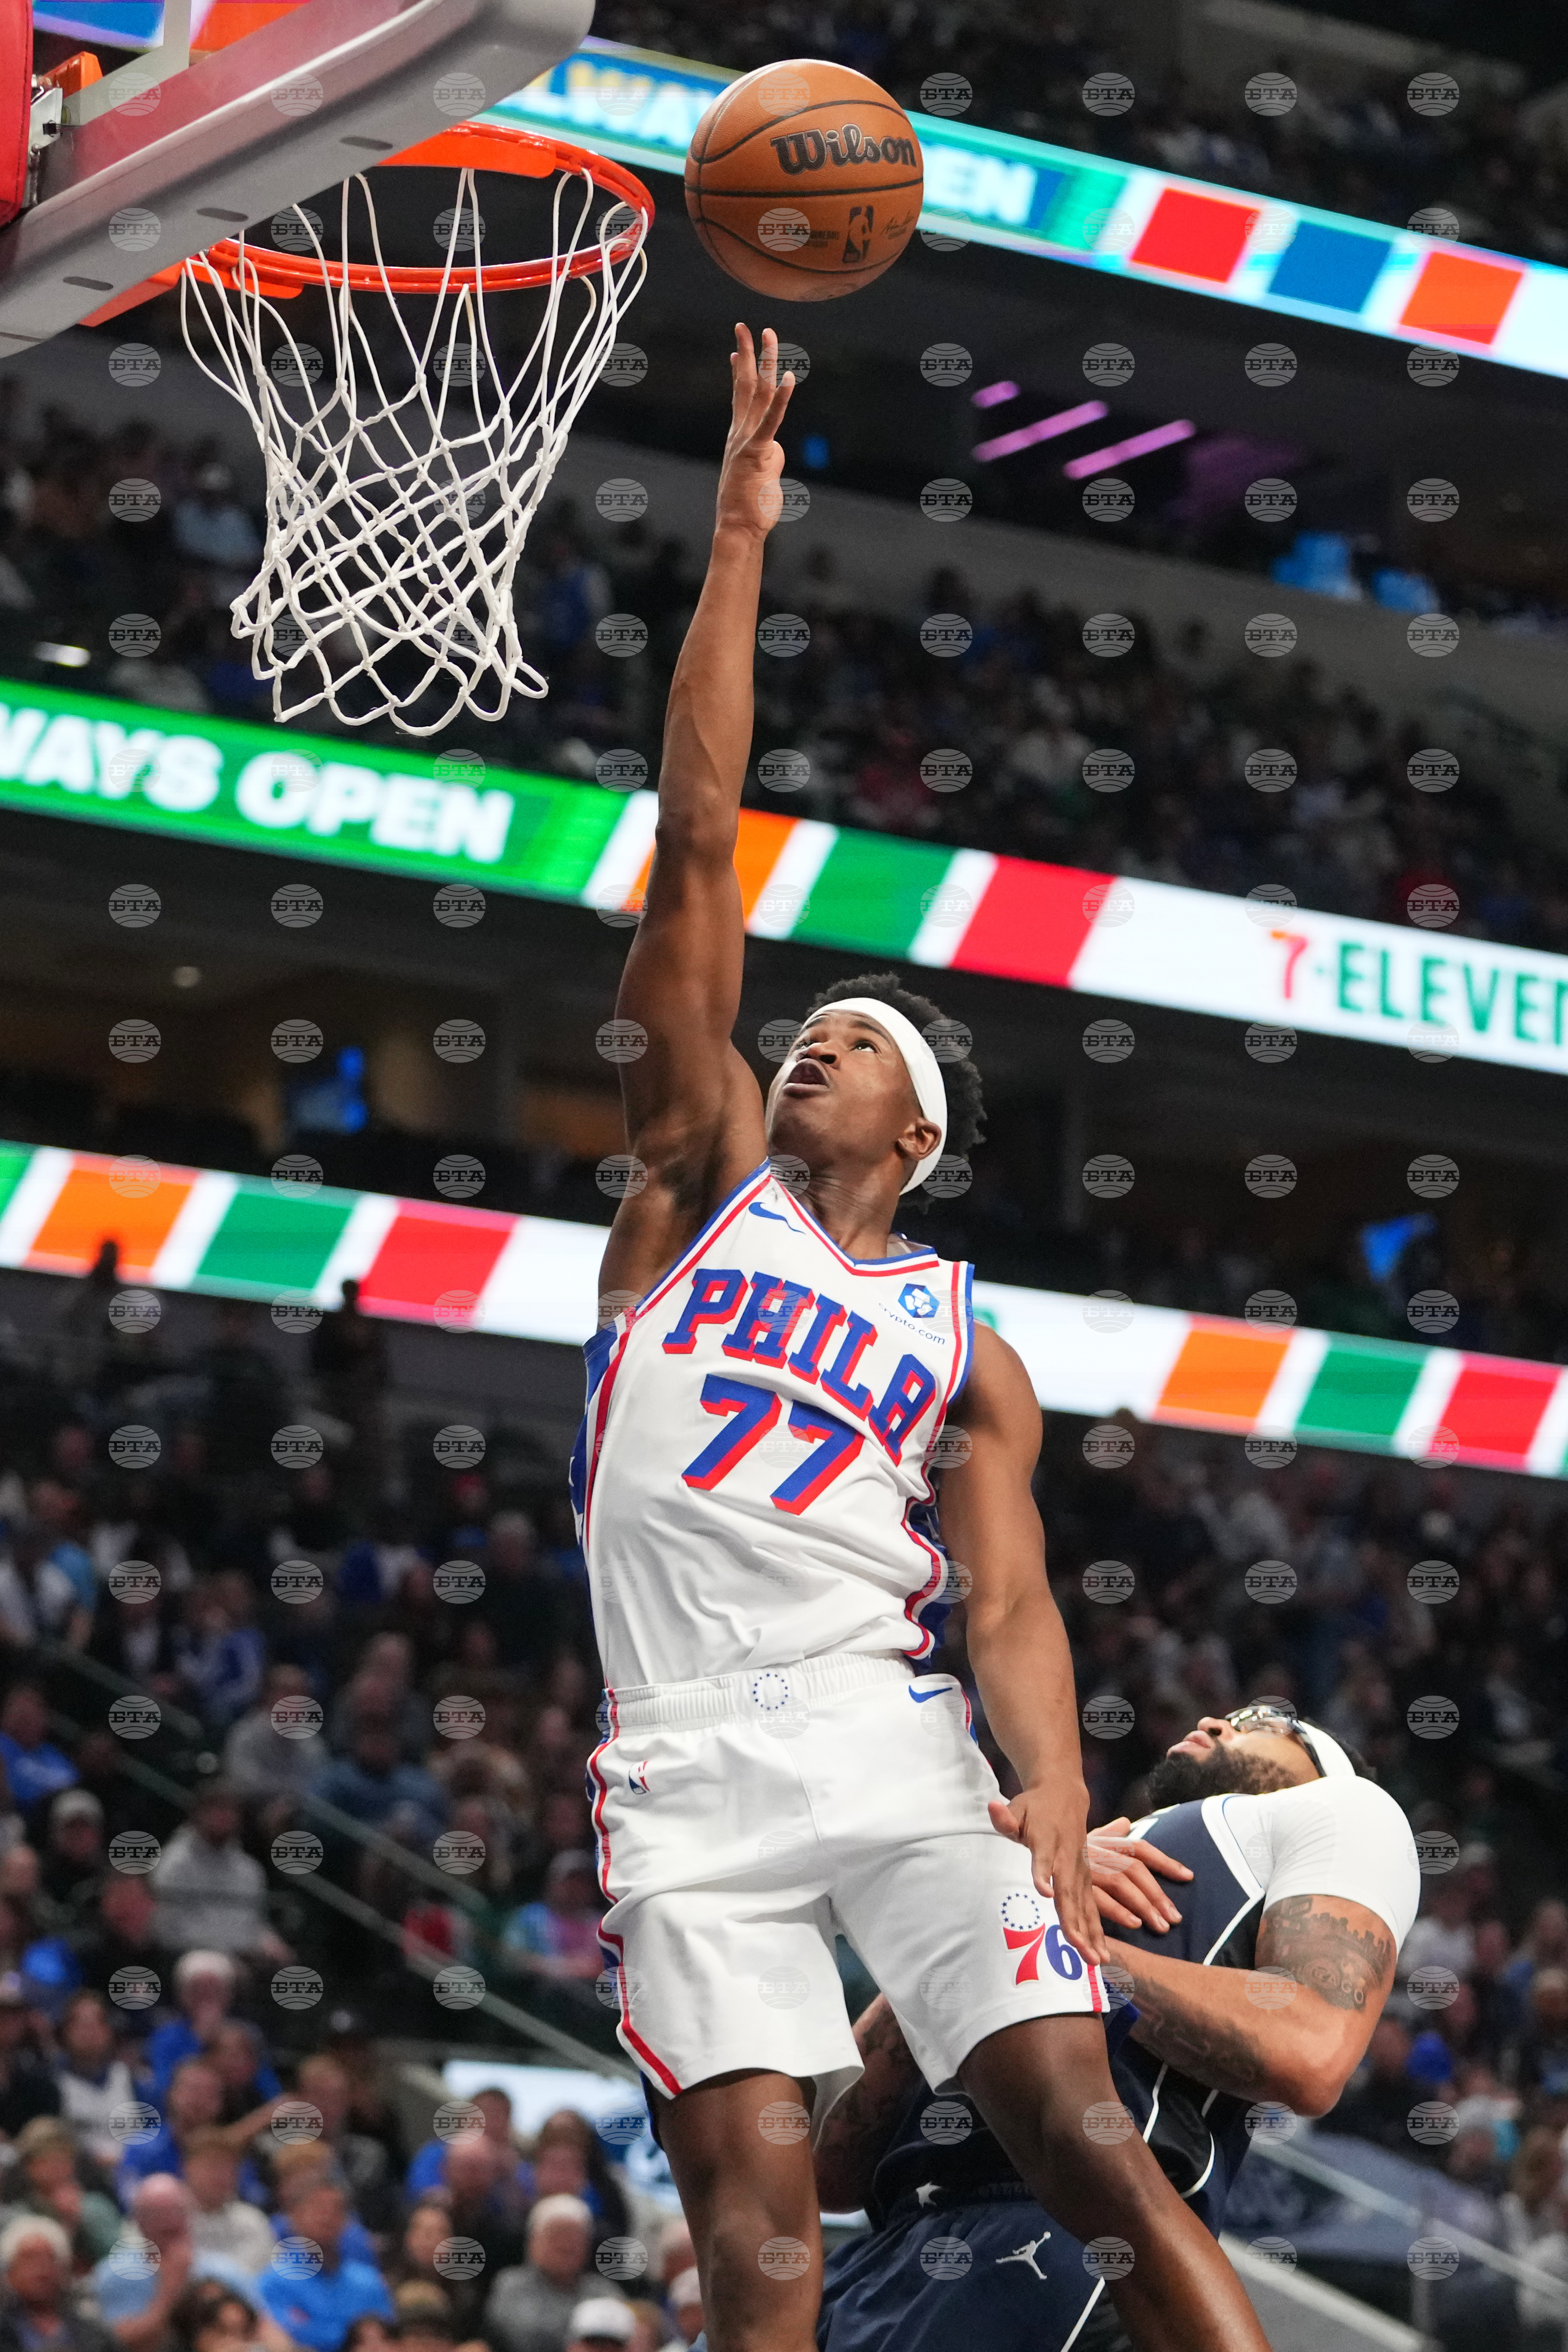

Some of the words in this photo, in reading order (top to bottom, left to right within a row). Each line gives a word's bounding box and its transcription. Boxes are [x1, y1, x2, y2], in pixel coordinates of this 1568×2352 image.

[770, 123, 917, 175] Wilson
[234, 750, 516, 865] OPEN
[661, 1268, 937, 1467] PHILA
[879, 1302, 945, 1345] crypto.com
[681, 1373, 867, 1516] 77
[1002, 1922, 1082, 1986] 76
